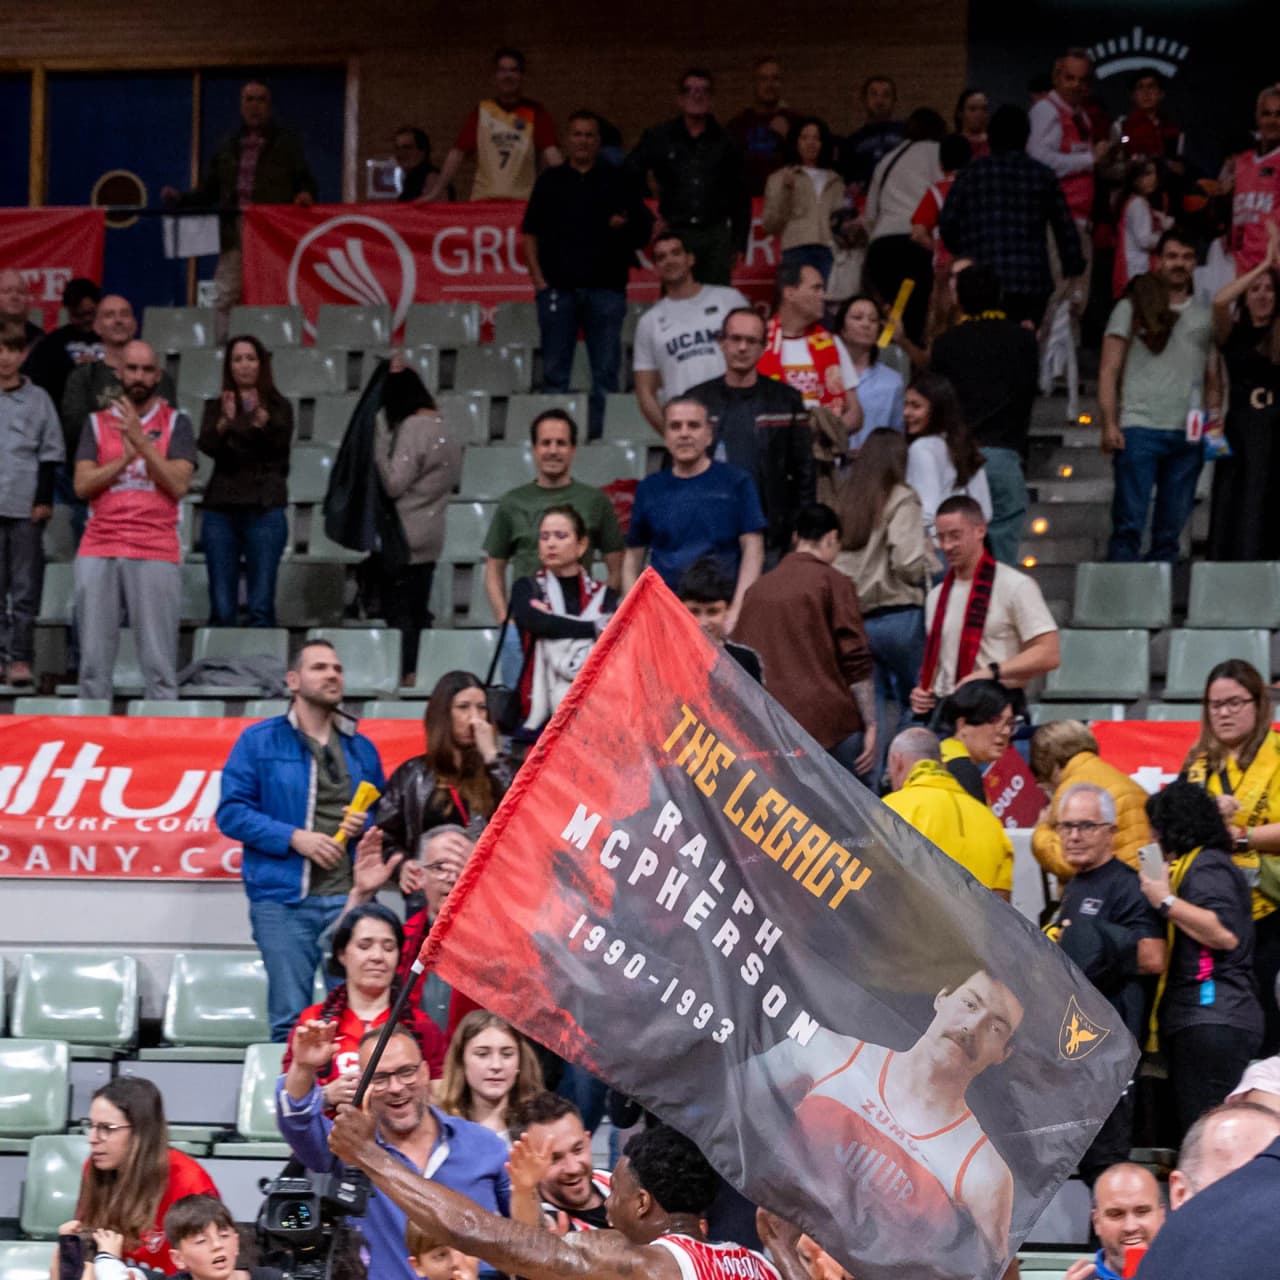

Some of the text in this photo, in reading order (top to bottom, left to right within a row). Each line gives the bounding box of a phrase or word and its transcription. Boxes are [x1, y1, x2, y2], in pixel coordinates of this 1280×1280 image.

[653, 799, 783, 956] RALPH
[663, 703, 873, 911] THE LEGACY
[561, 803, 820, 1047] MCPHERSON
[568, 914, 735, 1044] 1990-1993
